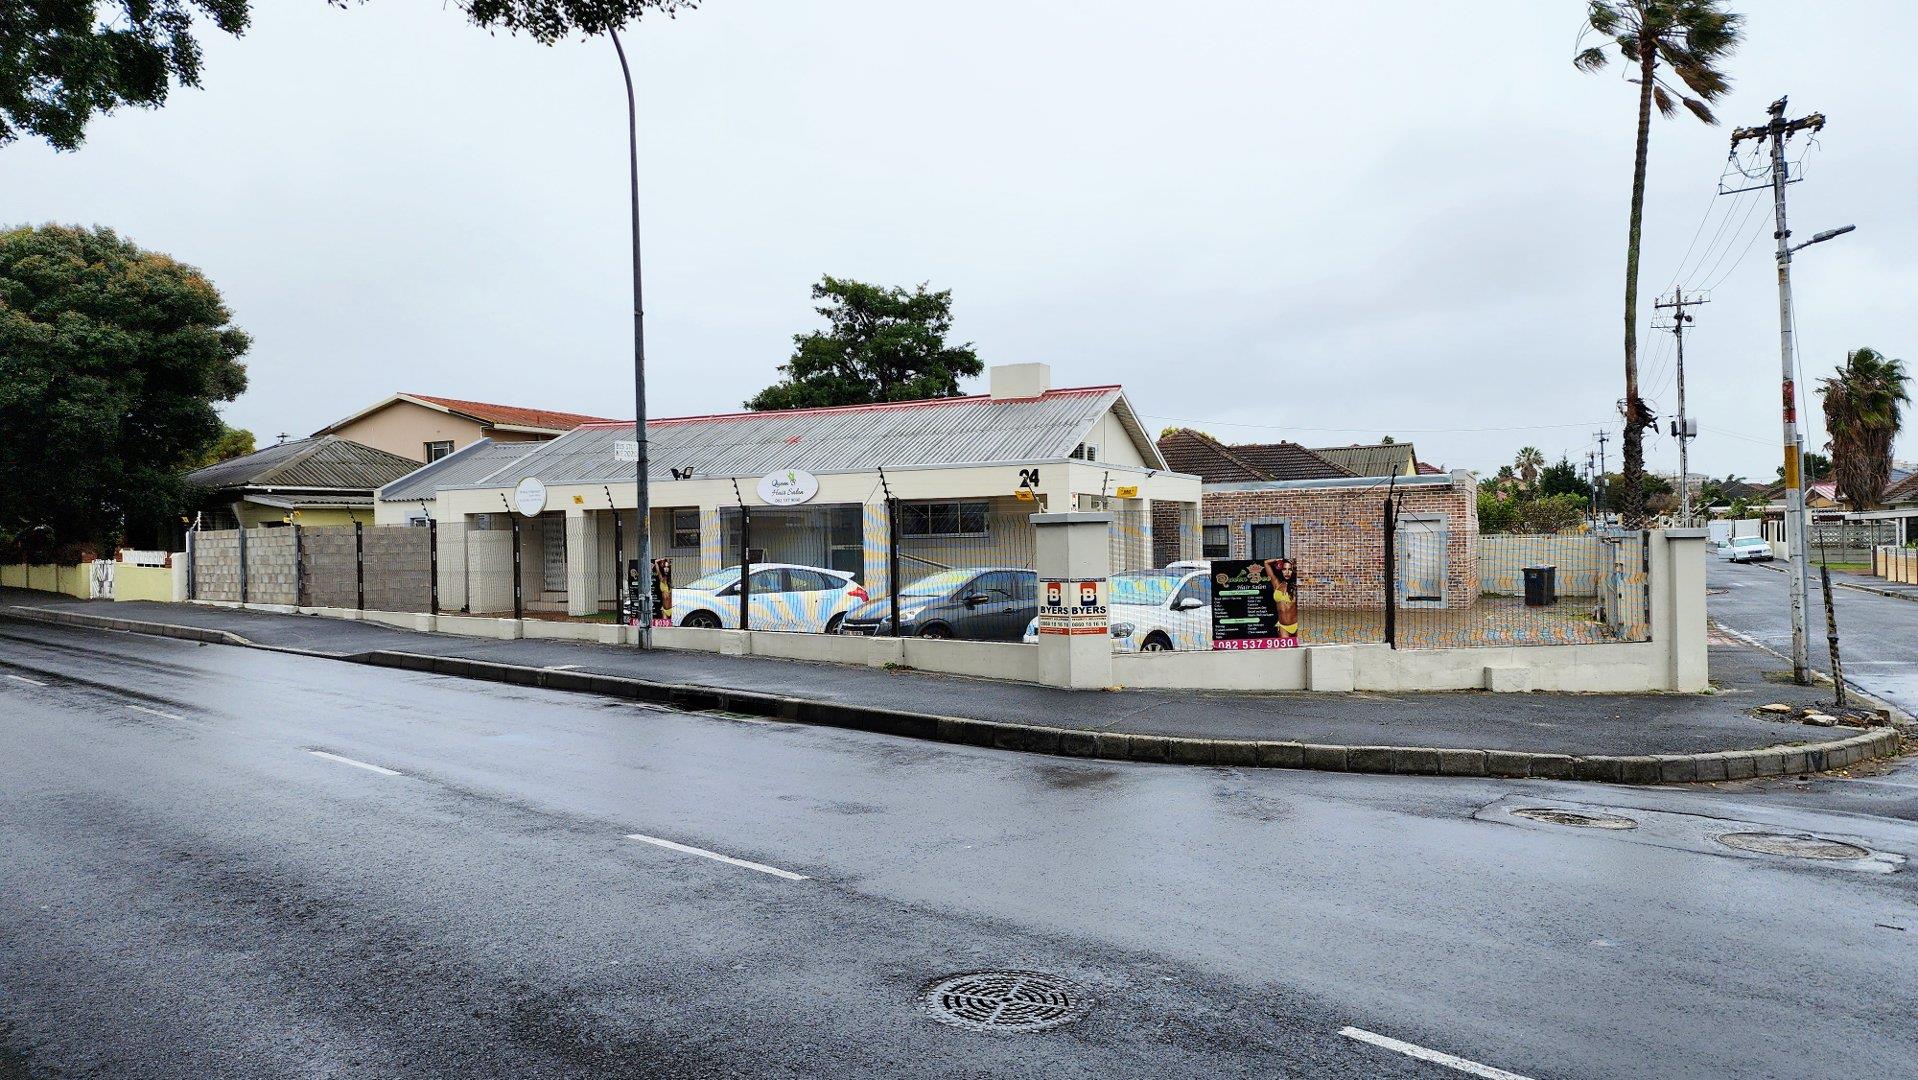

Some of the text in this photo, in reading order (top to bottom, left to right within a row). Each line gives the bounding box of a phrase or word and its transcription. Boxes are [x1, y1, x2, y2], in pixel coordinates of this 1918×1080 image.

[1019, 469, 1039, 487] 24
[1040, 606, 1069, 615] BYERS
[1071, 605, 1107, 615] BYERS
[1218, 638, 1294, 650] 082 537 9030
